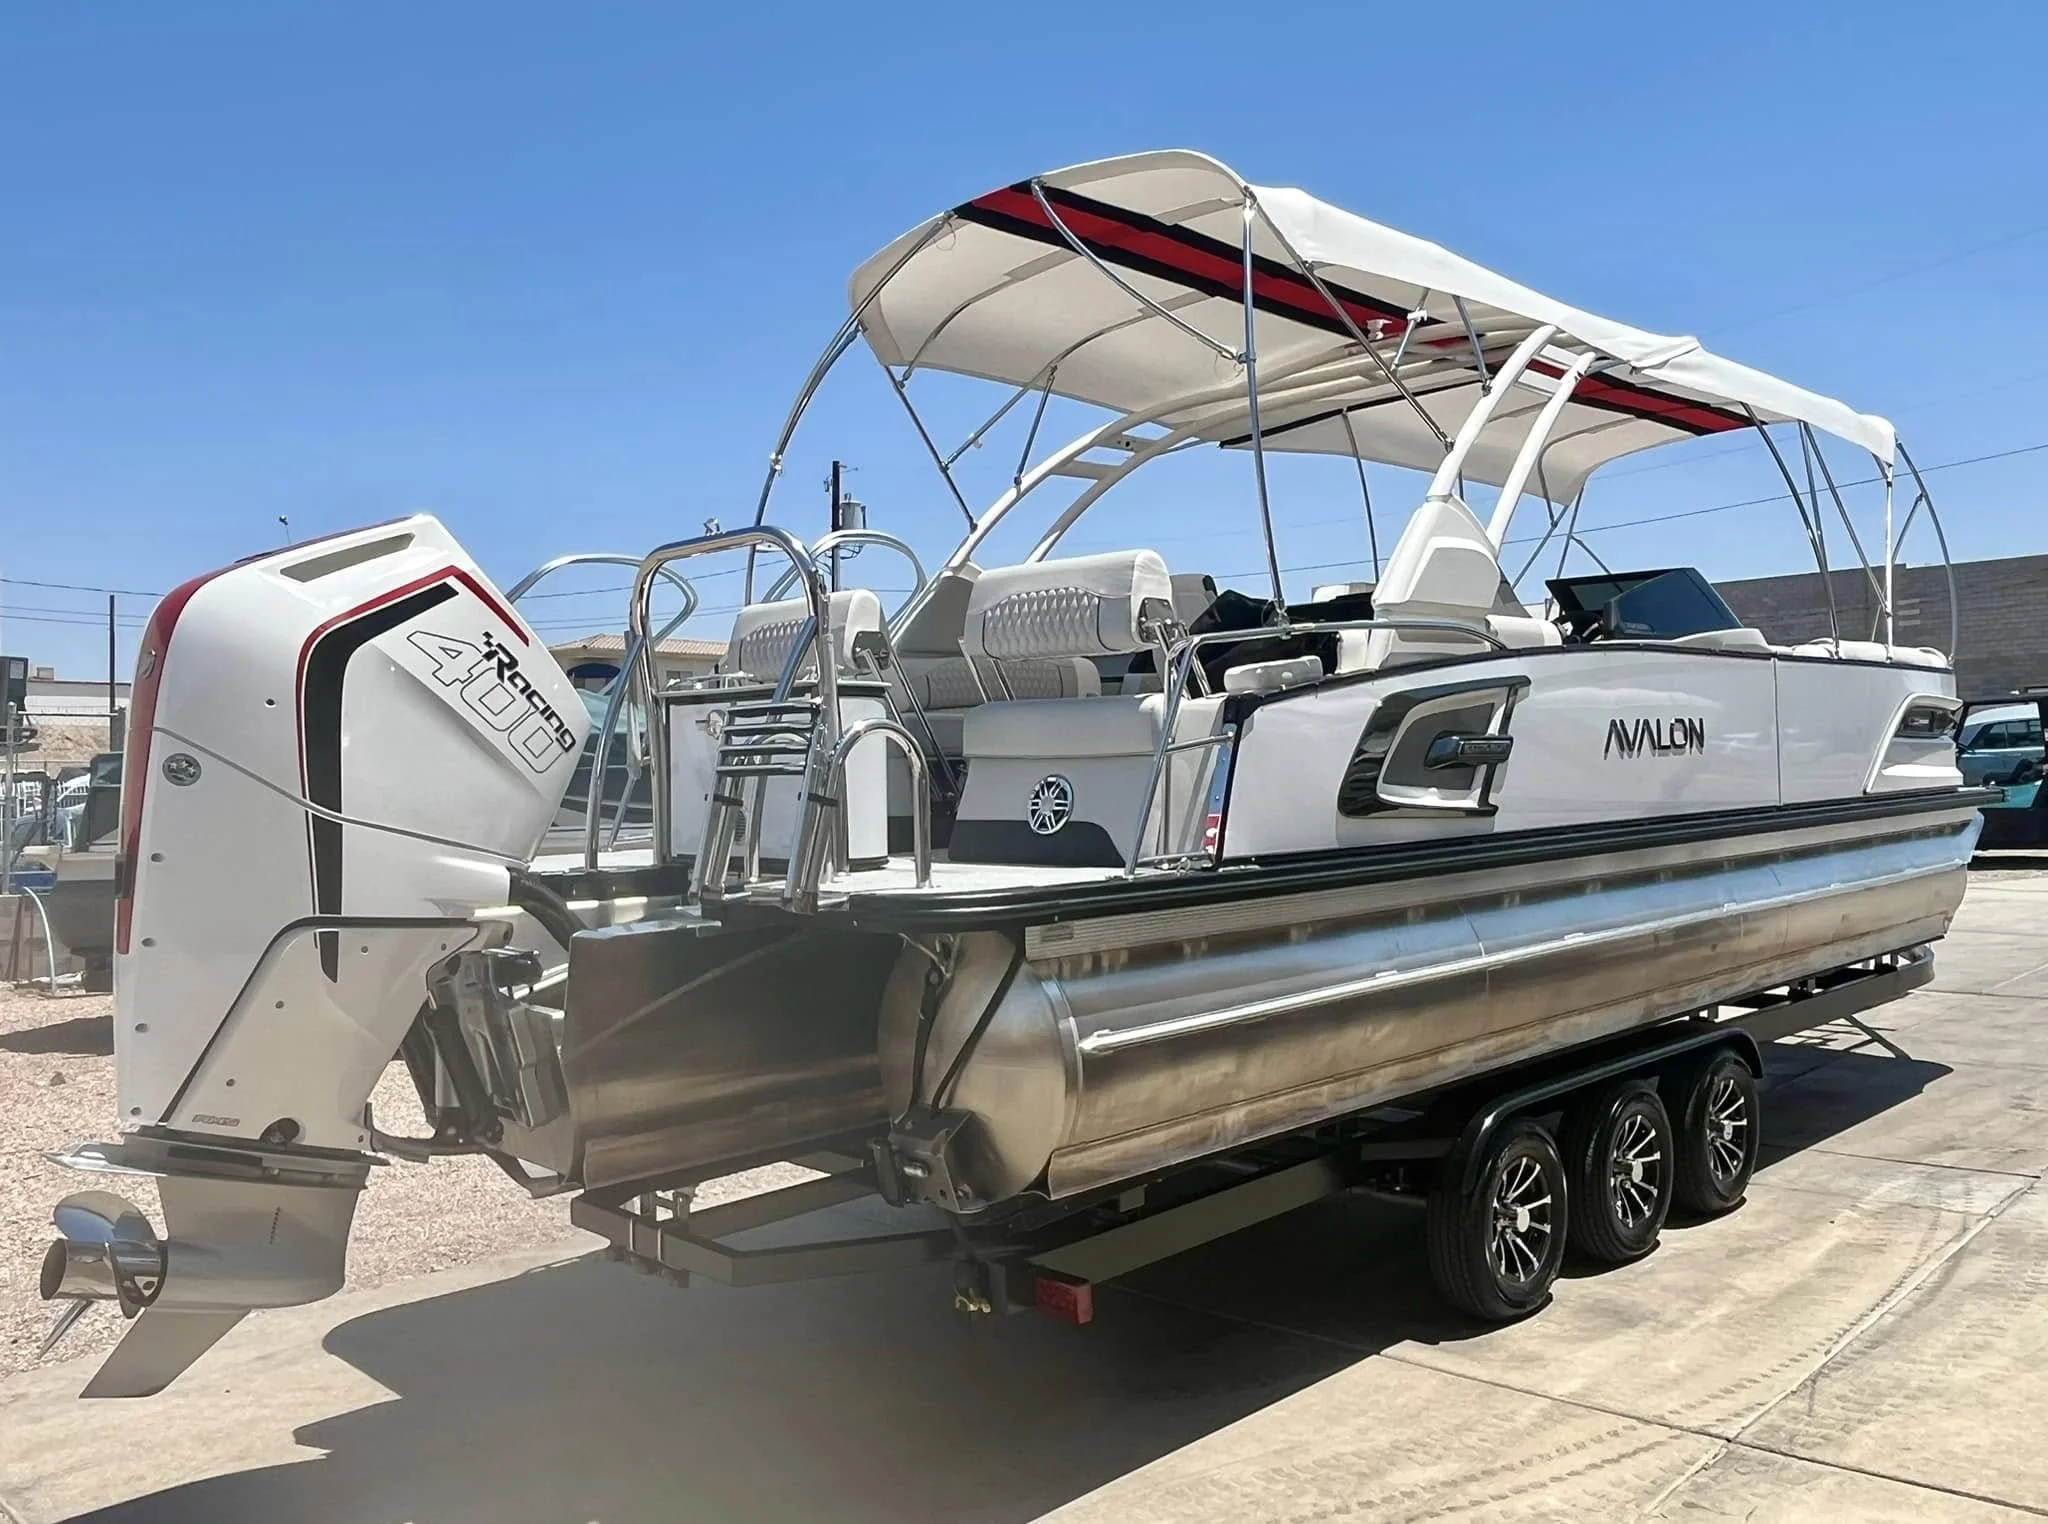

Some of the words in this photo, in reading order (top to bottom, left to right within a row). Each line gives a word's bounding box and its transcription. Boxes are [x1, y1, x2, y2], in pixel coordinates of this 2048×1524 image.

[406, 630, 564, 774] 400
[482, 631, 577, 753] Racing
[1603, 717, 1705, 758] AVALON
